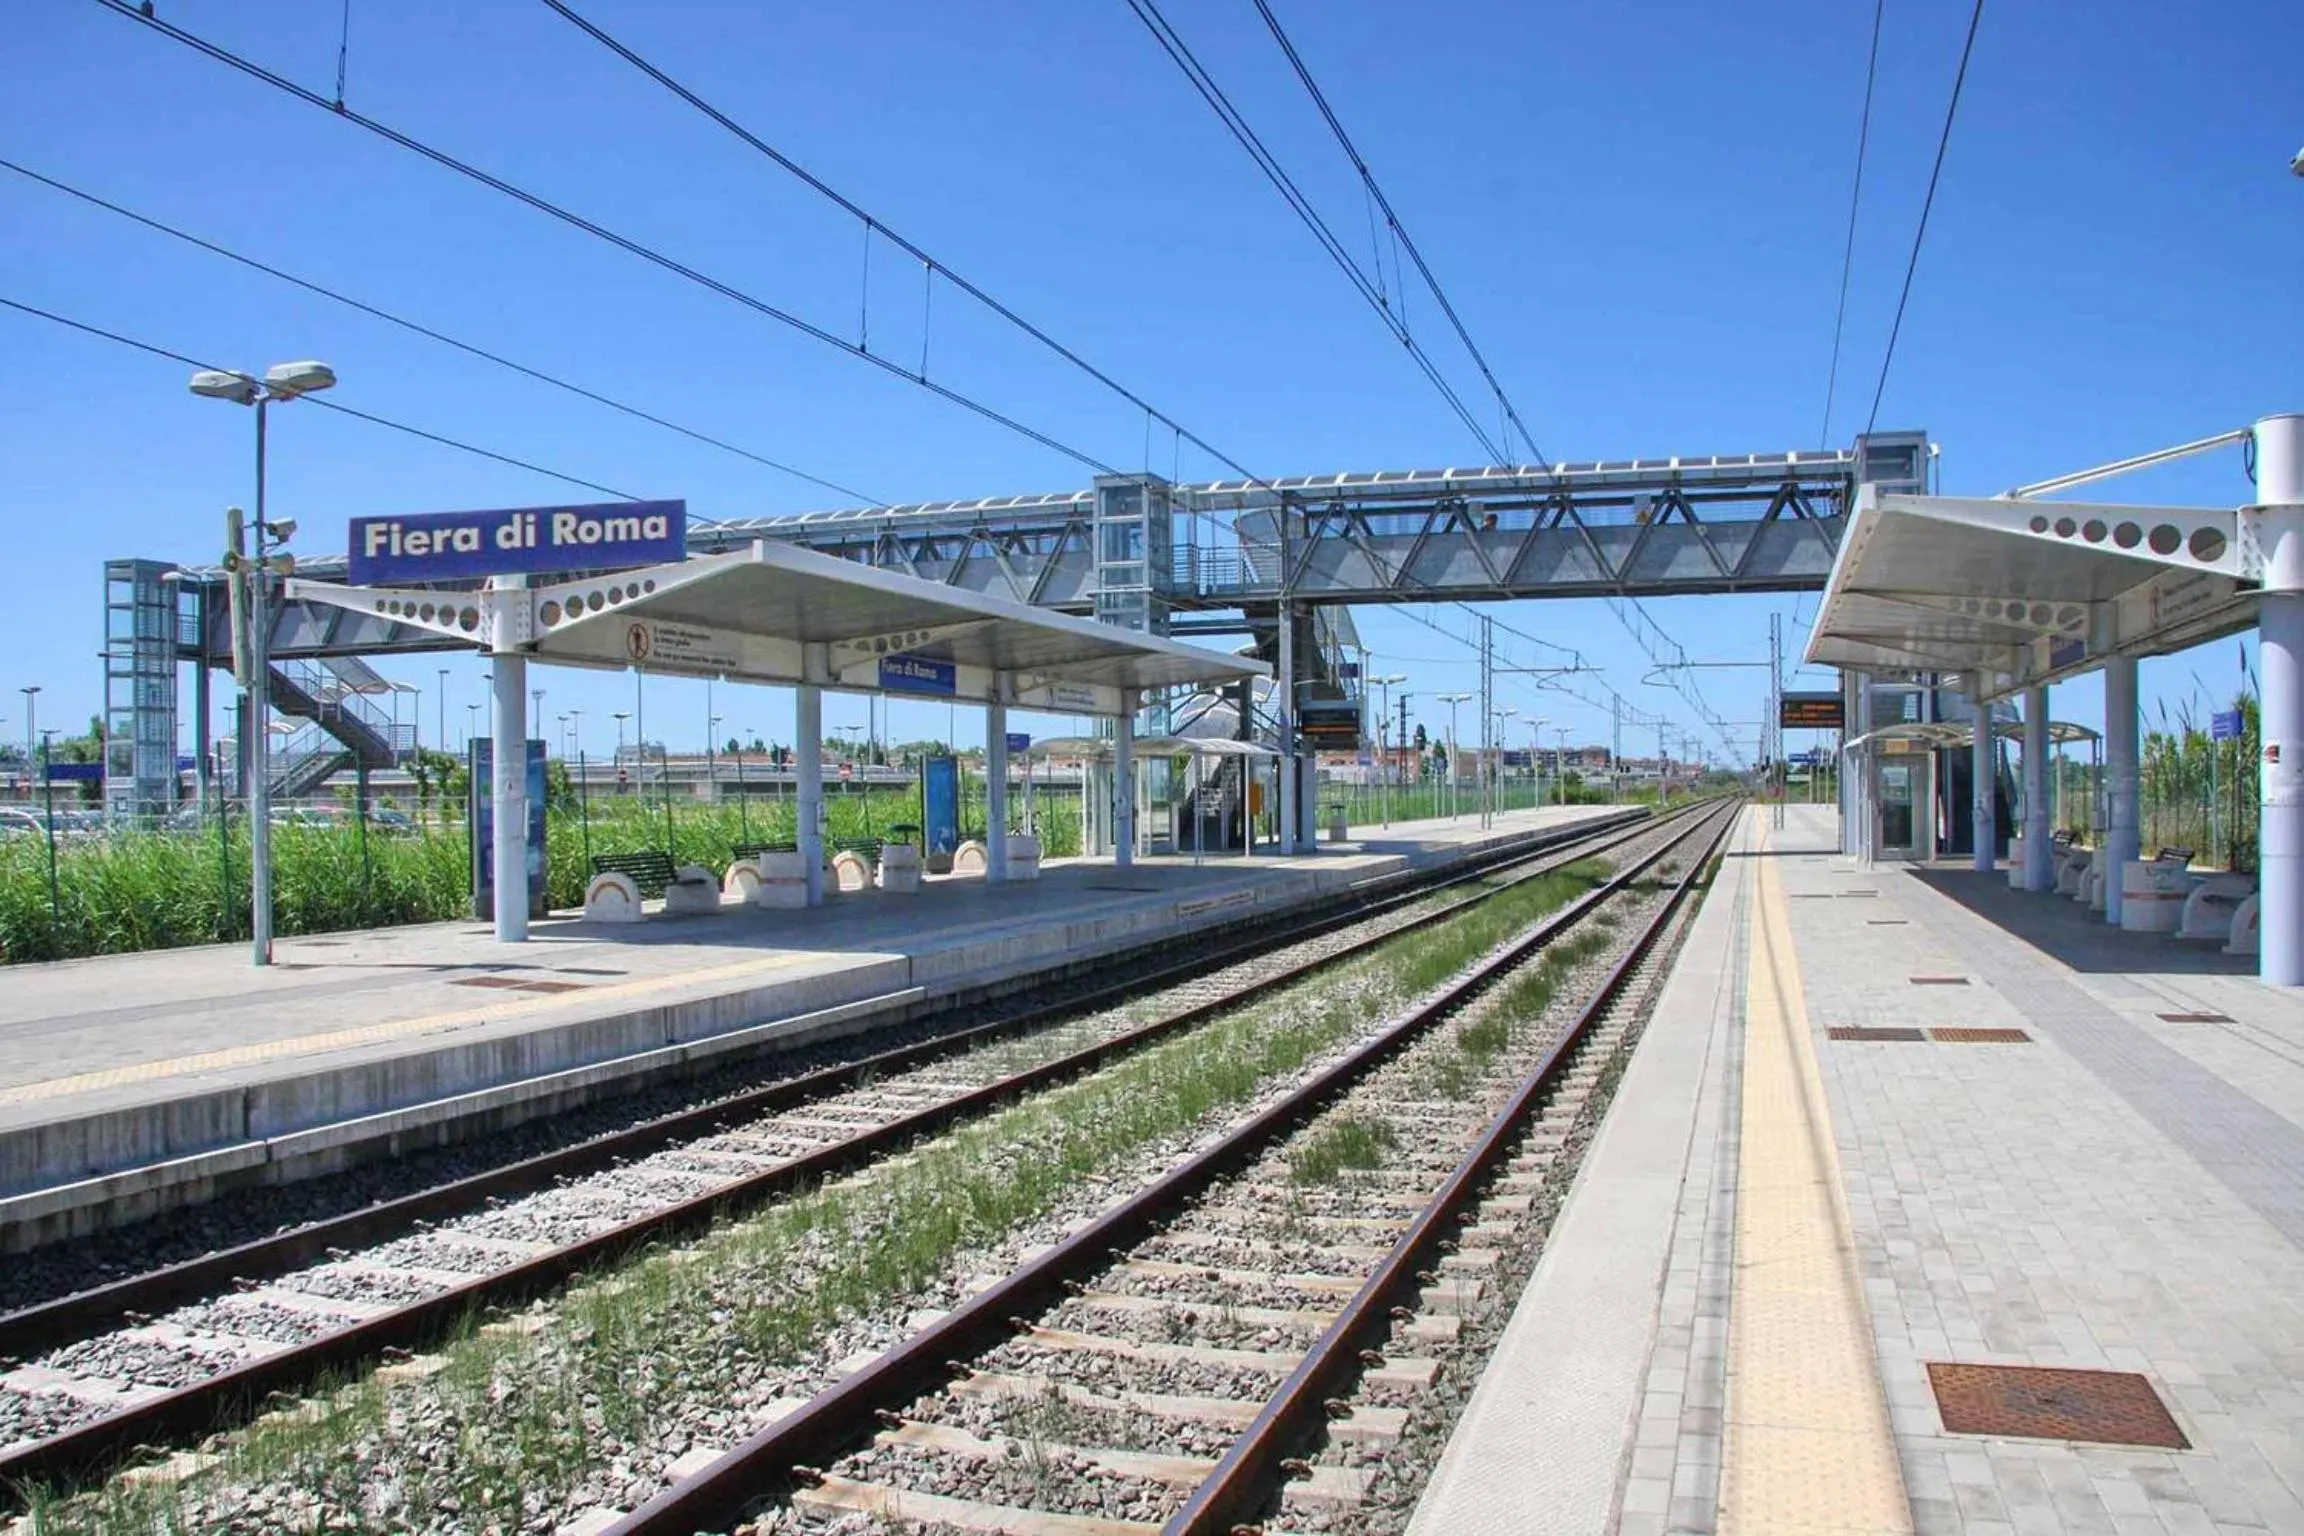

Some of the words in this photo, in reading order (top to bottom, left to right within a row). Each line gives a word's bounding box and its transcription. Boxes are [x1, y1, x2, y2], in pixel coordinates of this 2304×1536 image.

[364, 522, 480, 558] Fiera
[496, 513, 536, 549] di
[553, 512, 668, 547] Roma
